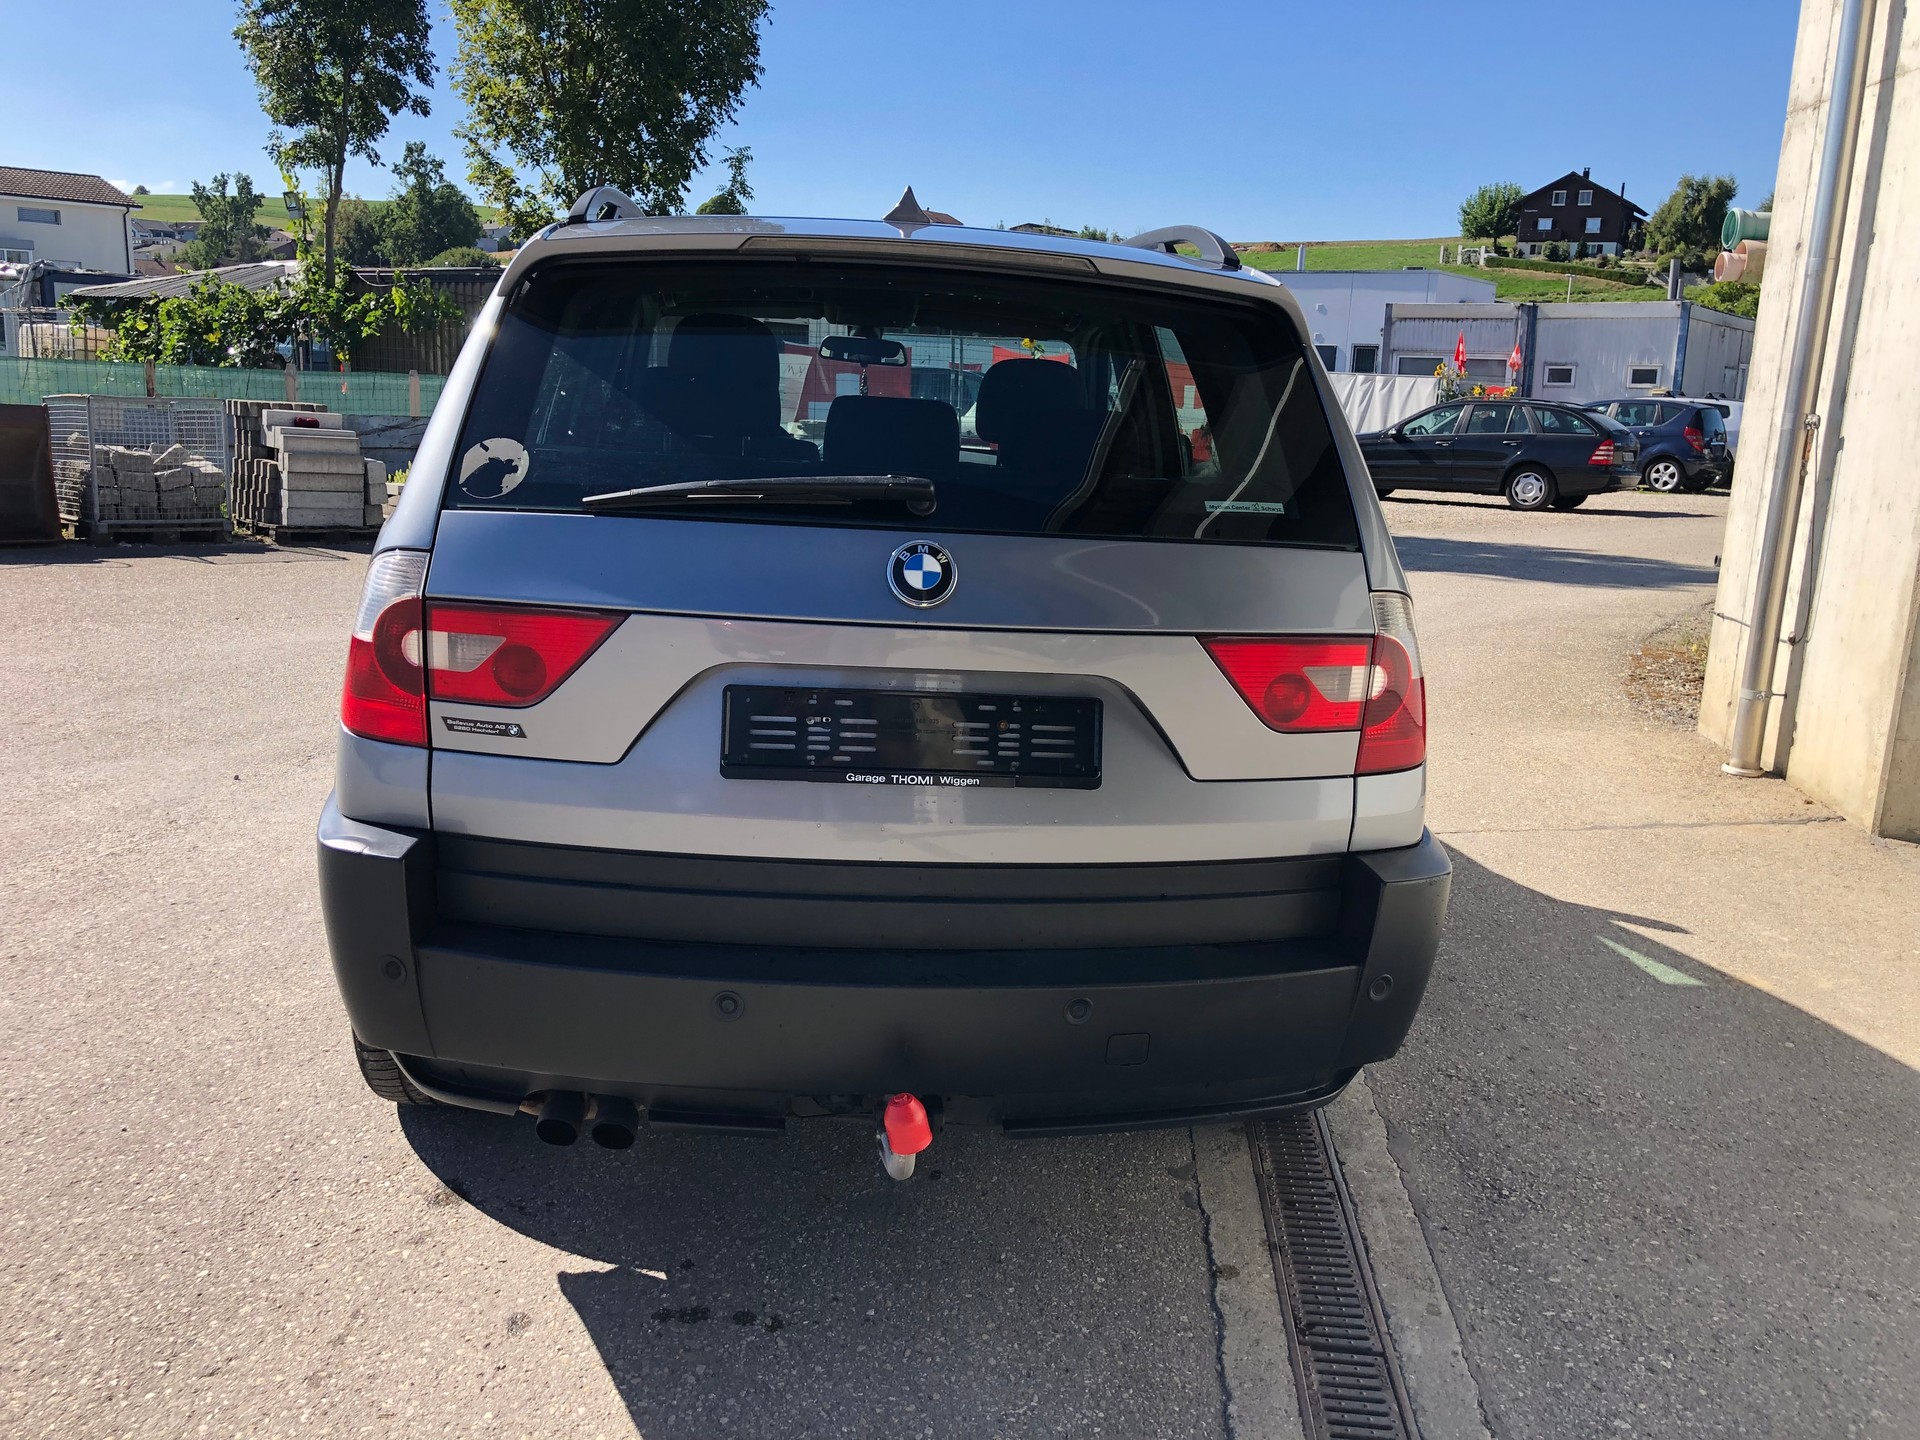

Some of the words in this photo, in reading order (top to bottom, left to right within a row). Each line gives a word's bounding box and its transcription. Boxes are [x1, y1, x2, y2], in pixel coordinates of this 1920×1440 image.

[899, 545, 949, 564] BMW
[446, 719, 475, 727] Bellevue
[846, 773, 886, 784] Garage
[891, 774, 933, 785] THOMI
[939, 776, 980, 786] Wiggen
